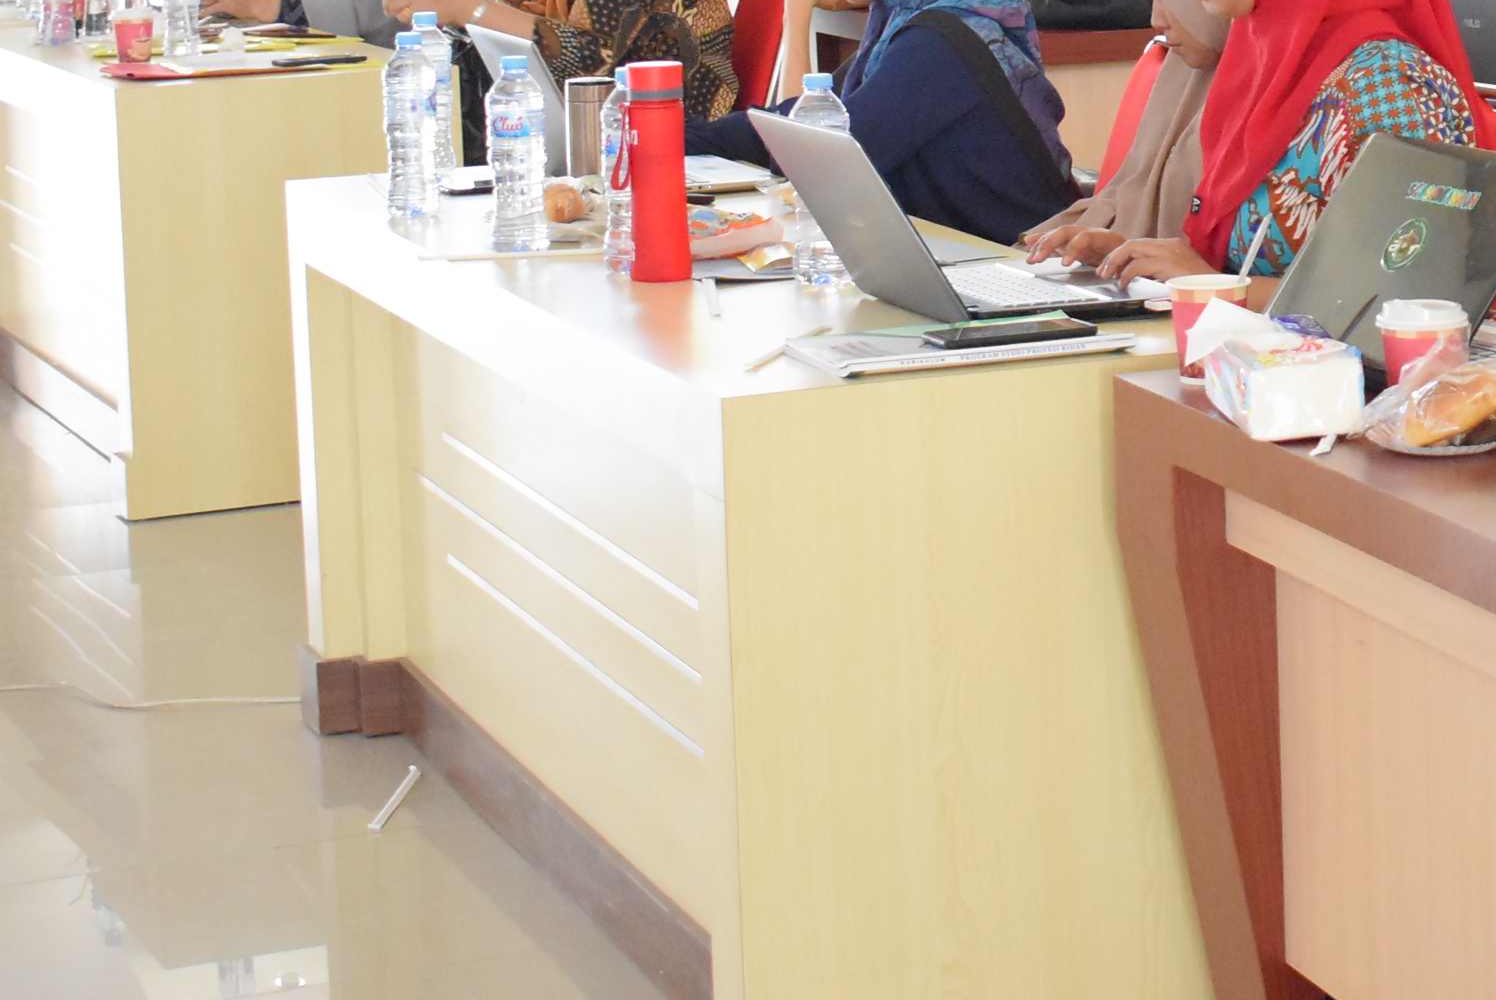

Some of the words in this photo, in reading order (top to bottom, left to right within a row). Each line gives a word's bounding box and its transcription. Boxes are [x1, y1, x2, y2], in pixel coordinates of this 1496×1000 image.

[492, 116, 524, 133] Club
[900, 356, 946, 366] KURIKULUM
[960, 352, 1000, 361] PROGRAM
[1001, 350, 1026, 358] STUDI
[1027, 346, 1060, 356] PROFESI
[1061, 344, 1087, 353] BIDAN
